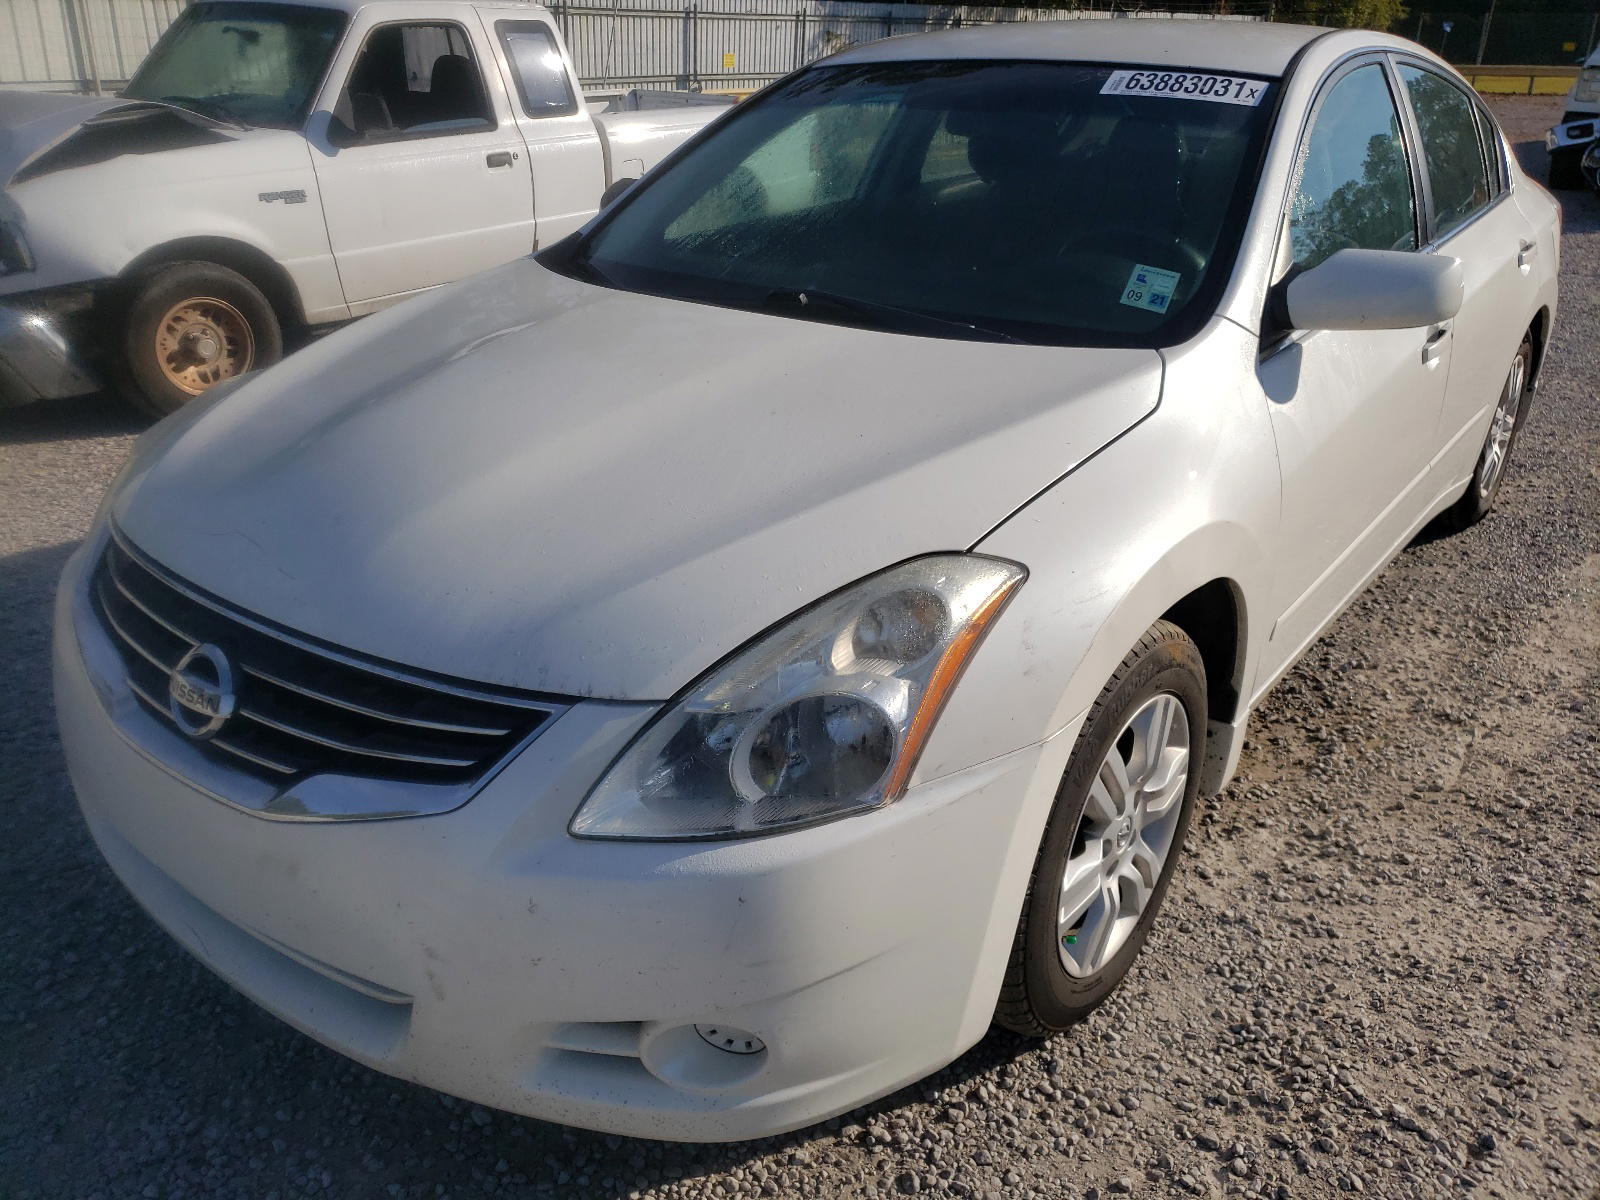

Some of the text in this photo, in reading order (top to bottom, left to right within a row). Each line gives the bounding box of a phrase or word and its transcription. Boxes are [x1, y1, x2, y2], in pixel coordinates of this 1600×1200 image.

[1124, 72, 1248, 99] 63883031
[1126, 289, 1166, 306] 09 21
